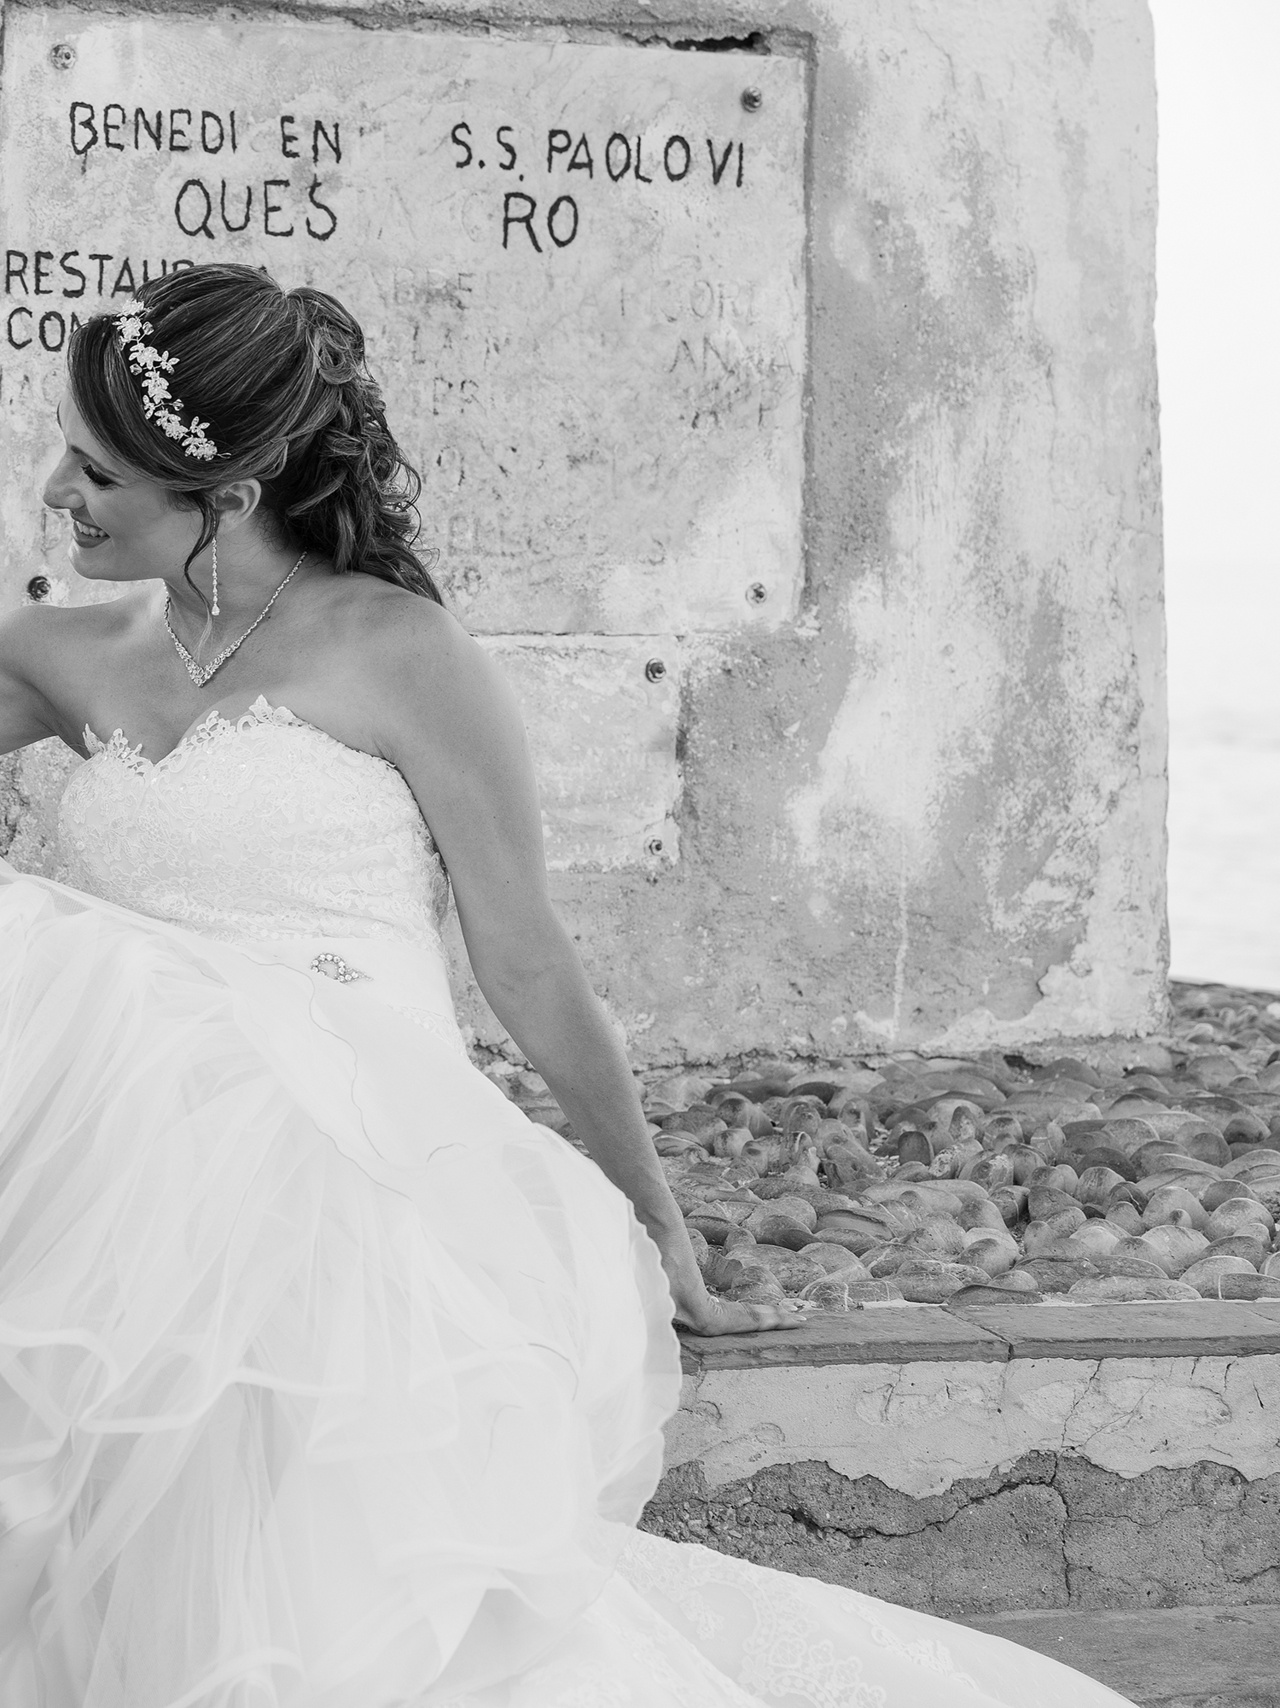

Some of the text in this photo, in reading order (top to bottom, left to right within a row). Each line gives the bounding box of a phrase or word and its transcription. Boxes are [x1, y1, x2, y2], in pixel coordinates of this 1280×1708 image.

[70, 102, 238, 156] BENEDI
[280, 116, 343, 164] EN
[547, 129, 692, 184] PAOLO
[707, 139, 744, 188] VI
[174, 179, 579, 253] QUES RO
